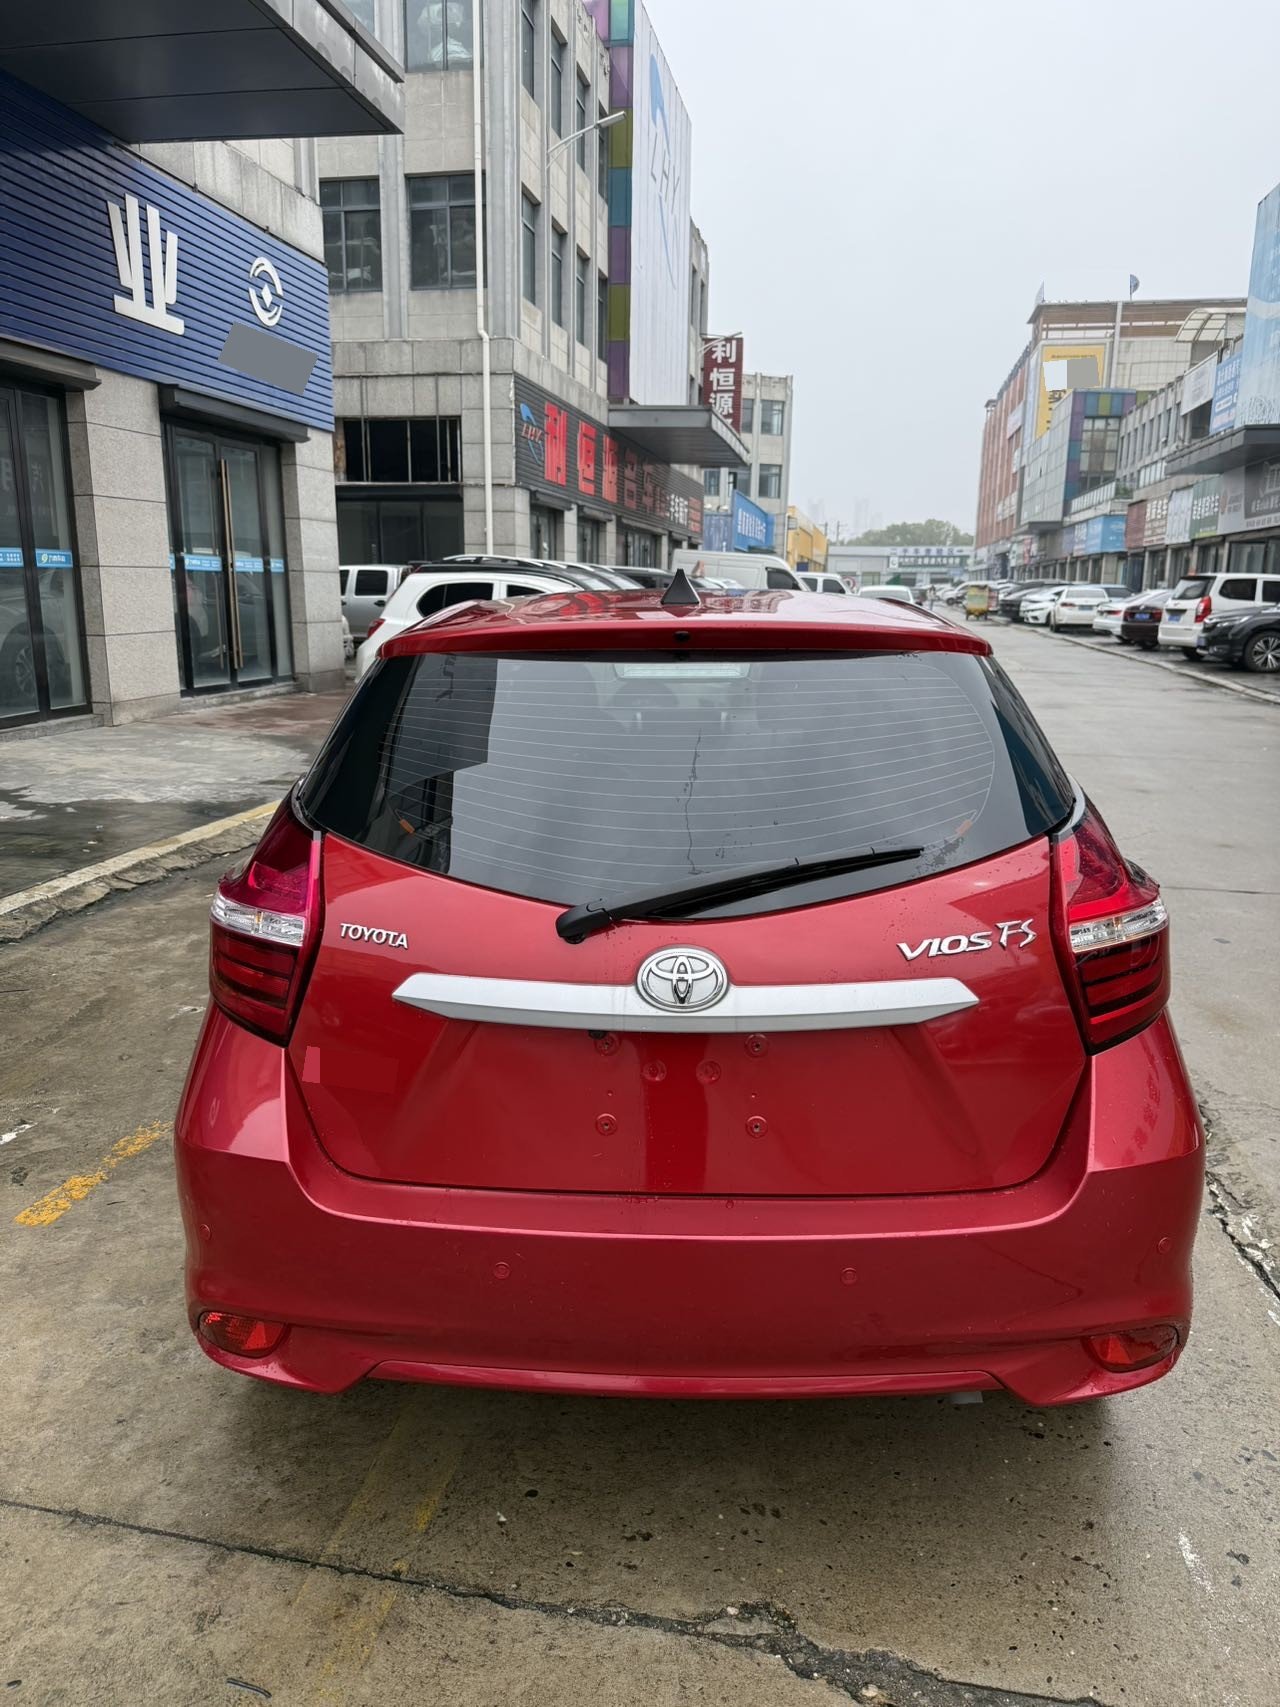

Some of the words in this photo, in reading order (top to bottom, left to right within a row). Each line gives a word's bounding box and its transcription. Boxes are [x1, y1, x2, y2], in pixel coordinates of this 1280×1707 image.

[650, 132, 680, 214] LHY
[107, 193, 185, 335] 业
[340, 923, 408, 949] TOYOTA
[896, 930, 993, 961] VIOS
[995, 918, 1037, 948] FS
